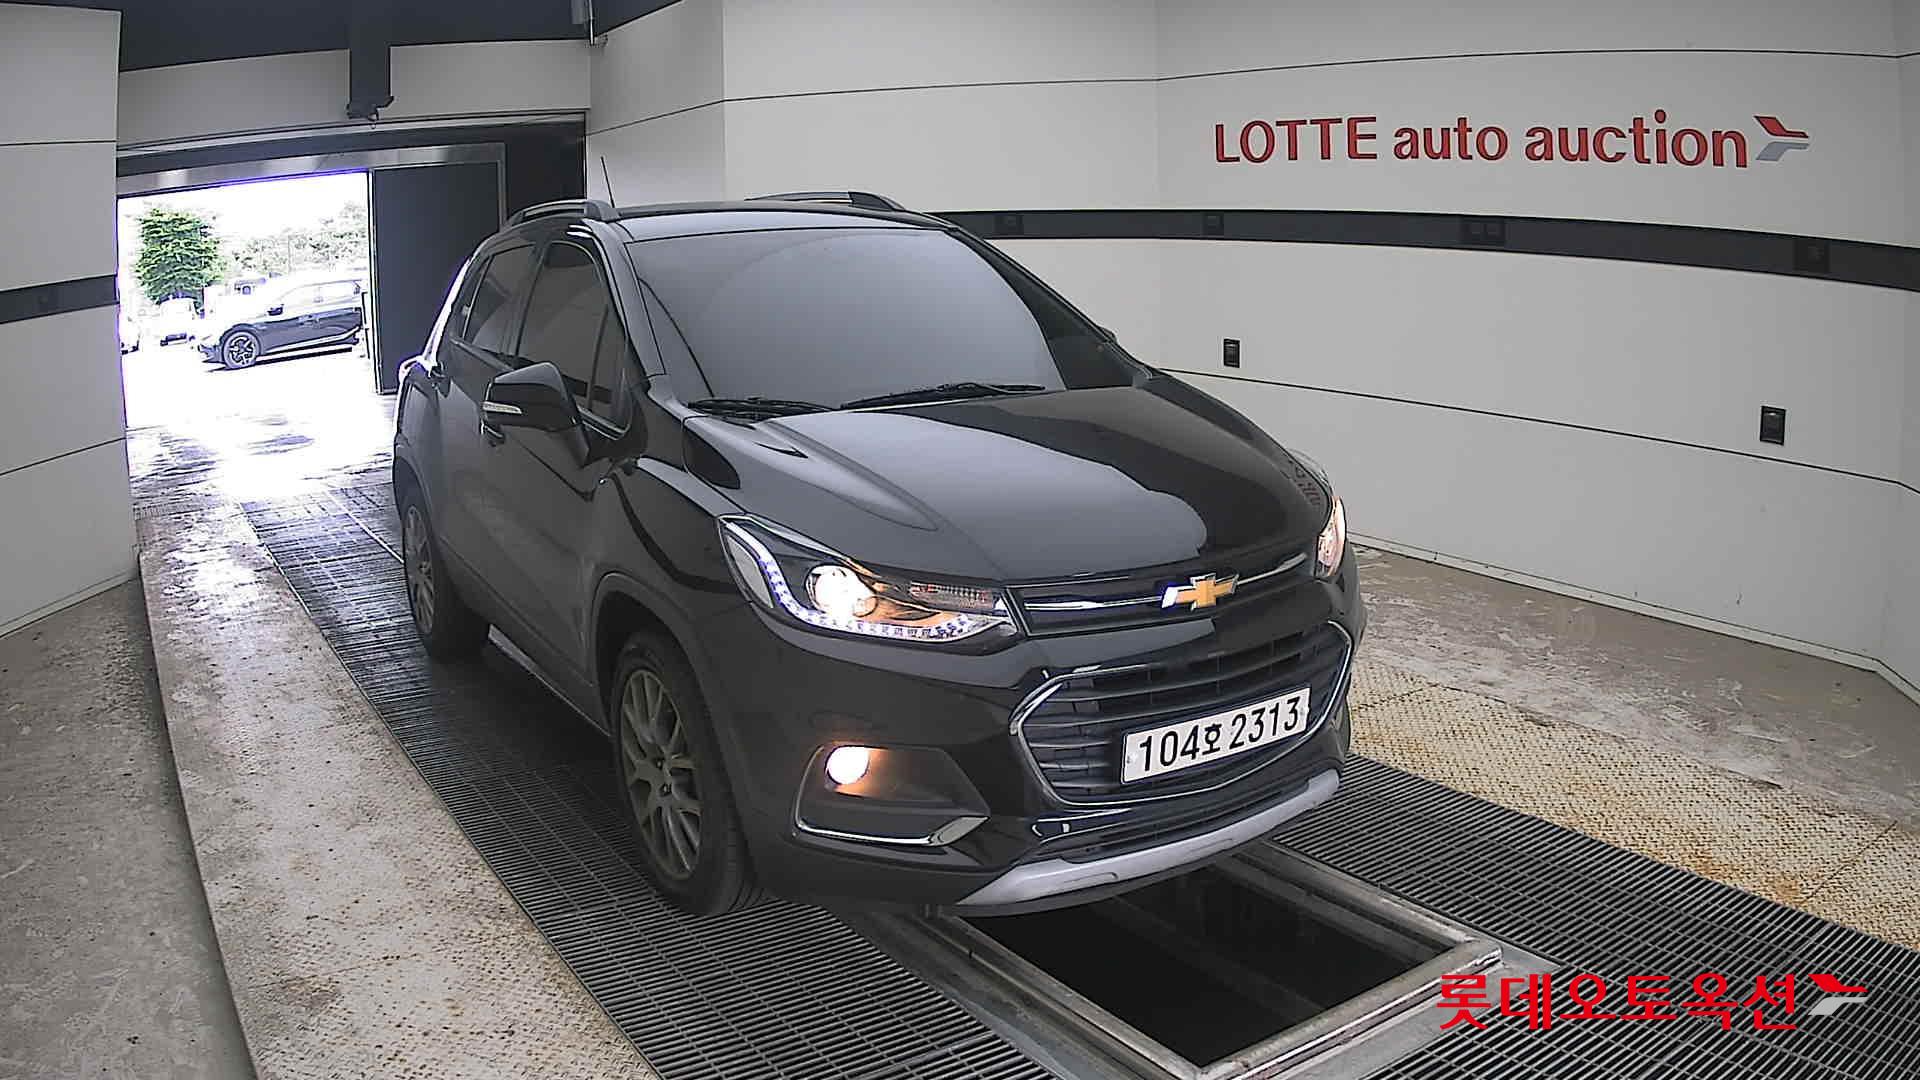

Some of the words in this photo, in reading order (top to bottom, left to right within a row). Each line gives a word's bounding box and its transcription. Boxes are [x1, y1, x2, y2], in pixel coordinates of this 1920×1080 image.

[1215, 116, 1377, 163] LOTTE
[1393, 116, 1508, 161] auto
[1525, 109, 1748, 168] auction
[1139, 723, 1222, 772] 104호
[1229, 696, 1301, 750] 2313
